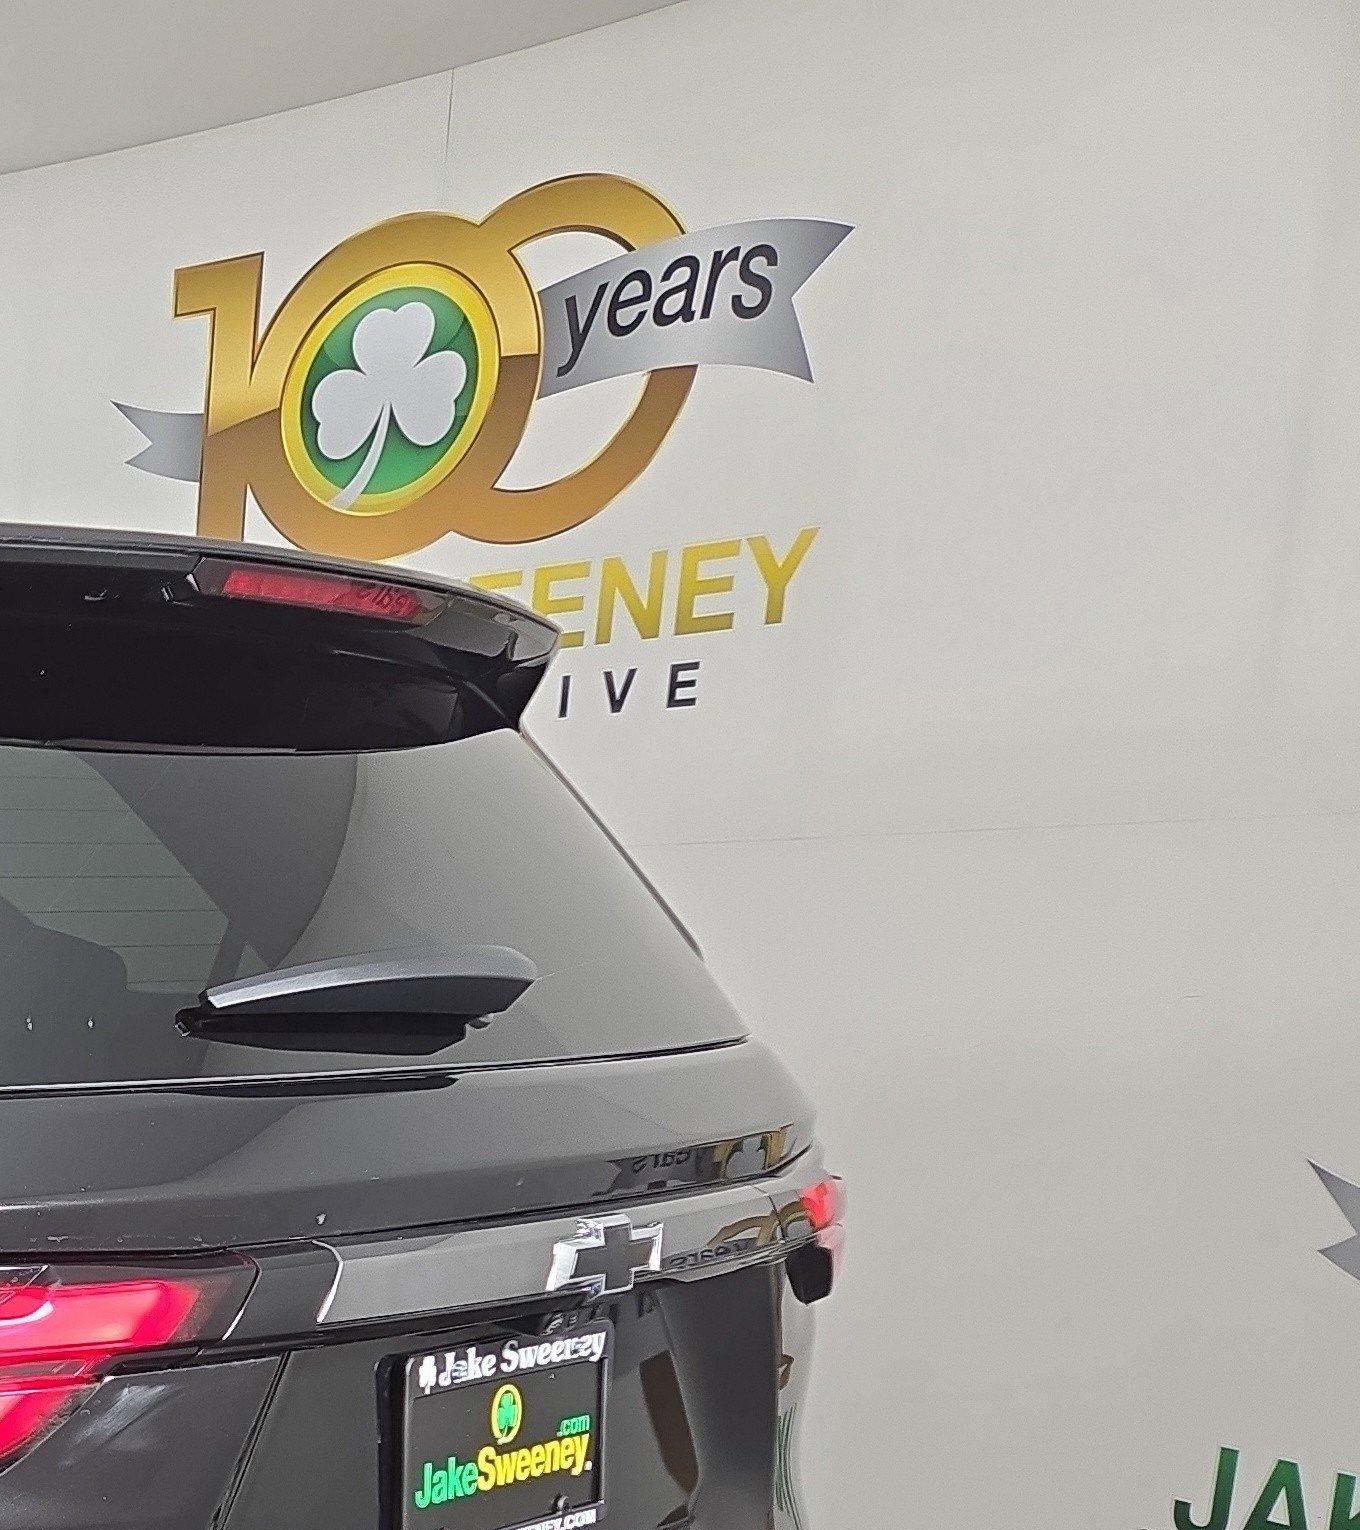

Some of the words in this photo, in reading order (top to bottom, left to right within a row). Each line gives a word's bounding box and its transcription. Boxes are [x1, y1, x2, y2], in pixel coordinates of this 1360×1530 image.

[556, 240, 779, 377] years
[468, 525, 821, 651] ENEY
[557, 659, 701, 719] IVE
